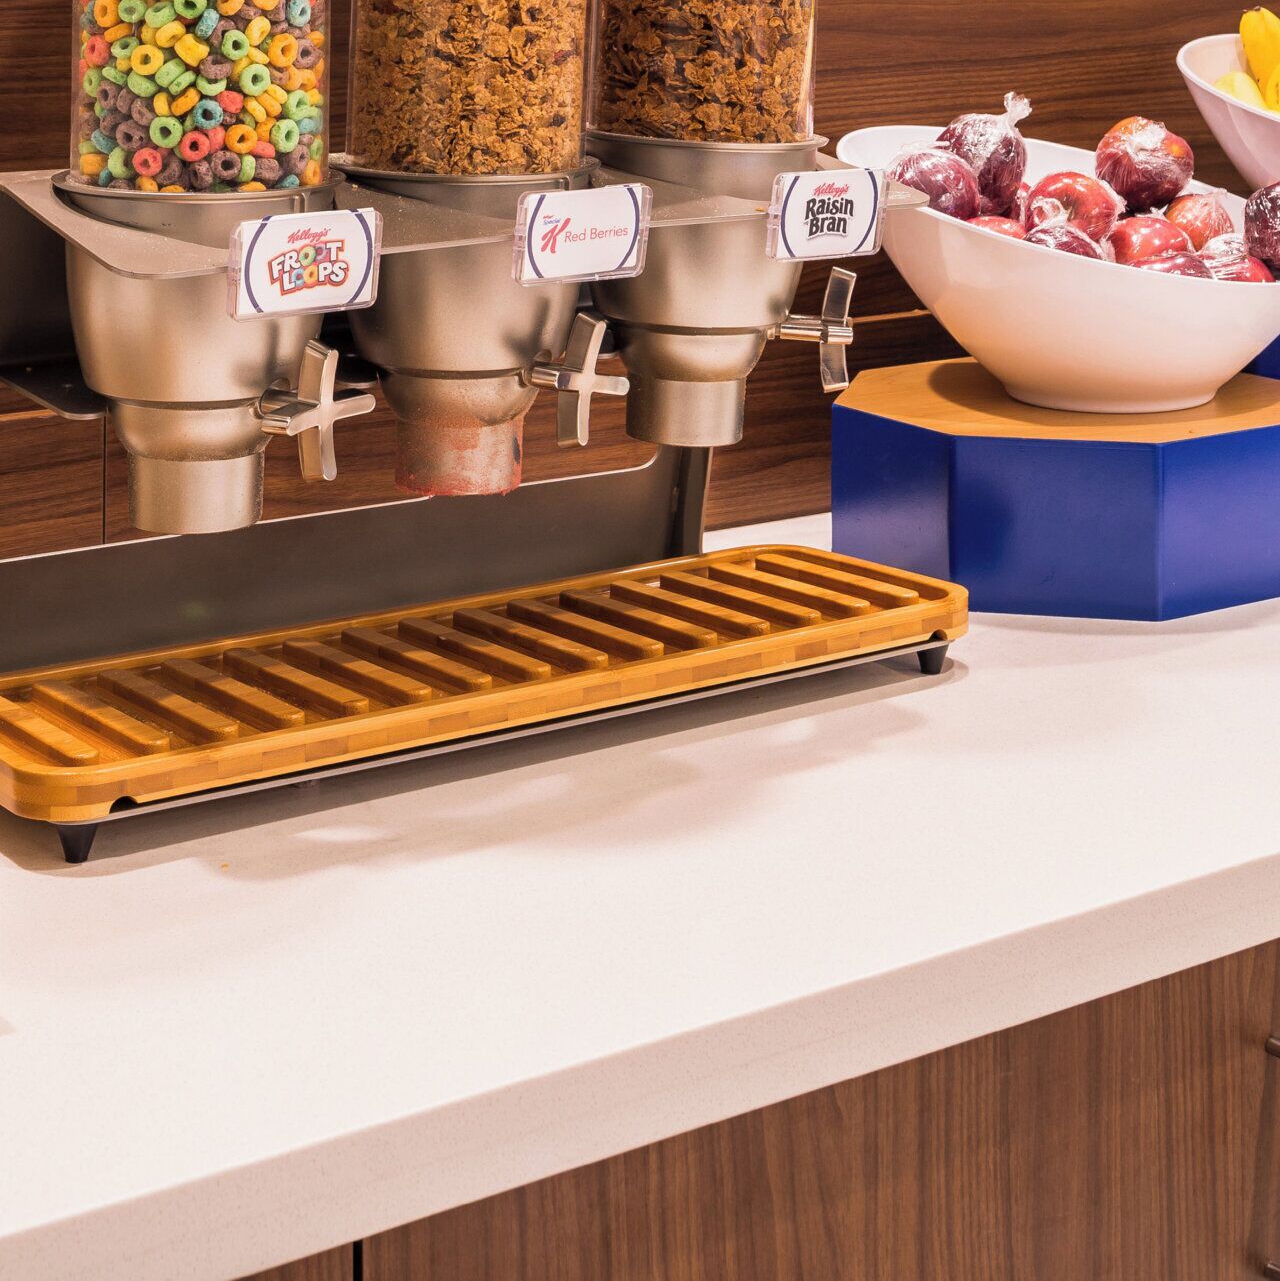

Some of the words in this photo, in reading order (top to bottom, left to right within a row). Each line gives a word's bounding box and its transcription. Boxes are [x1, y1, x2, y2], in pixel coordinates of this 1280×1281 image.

[813, 182, 849, 197] Kellogg's
[805, 197, 854, 220] Raisin
[287, 228, 331, 244] Kellogg's
[541, 217, 571, 253] K
[565, 229, 587, 243] Red
[589, 227, 628, 240] Berries
[808, 216, 848, 237] Bran
[270, 241, 343, 280] FROOT
[281, 261, 349, 292] LOOPS
